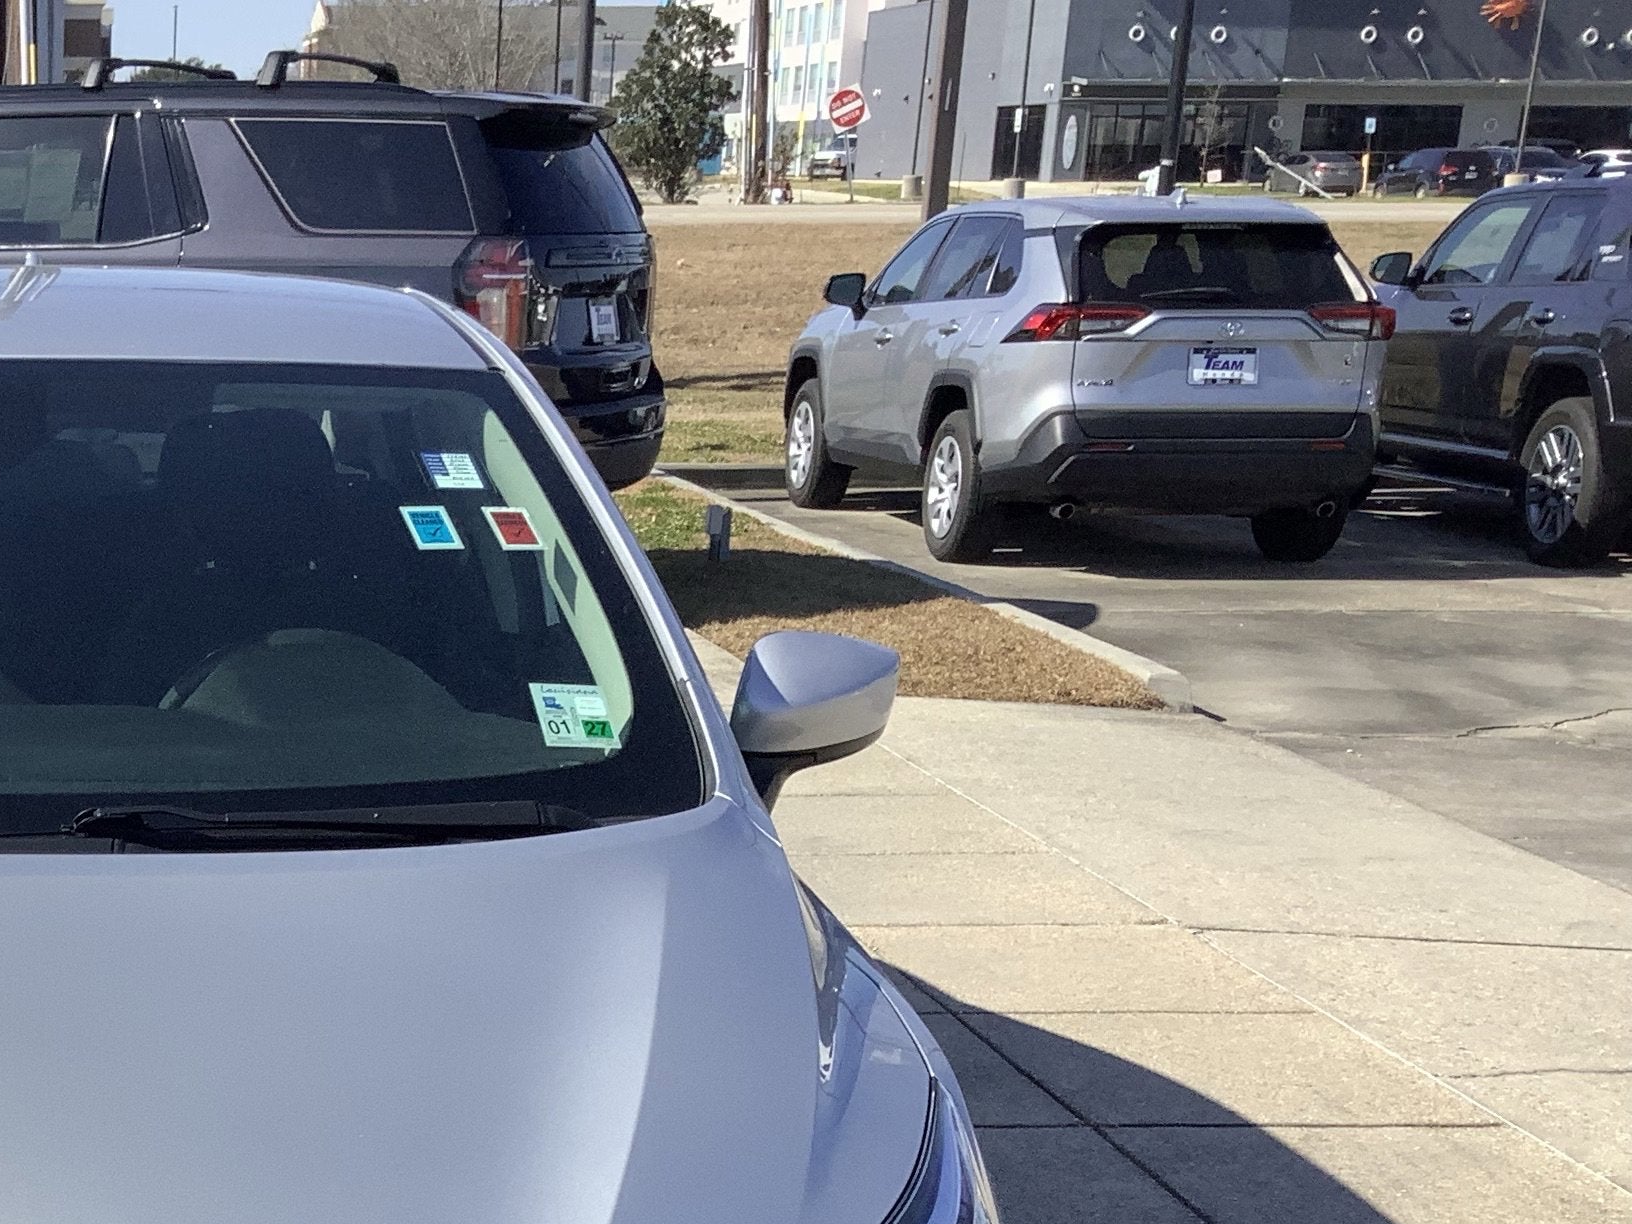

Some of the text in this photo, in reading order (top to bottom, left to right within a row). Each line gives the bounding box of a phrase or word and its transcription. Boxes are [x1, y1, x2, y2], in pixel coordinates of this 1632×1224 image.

[1204, 353, 1245, 371] TEAM
[548, 720, 607, 736] 01 27
